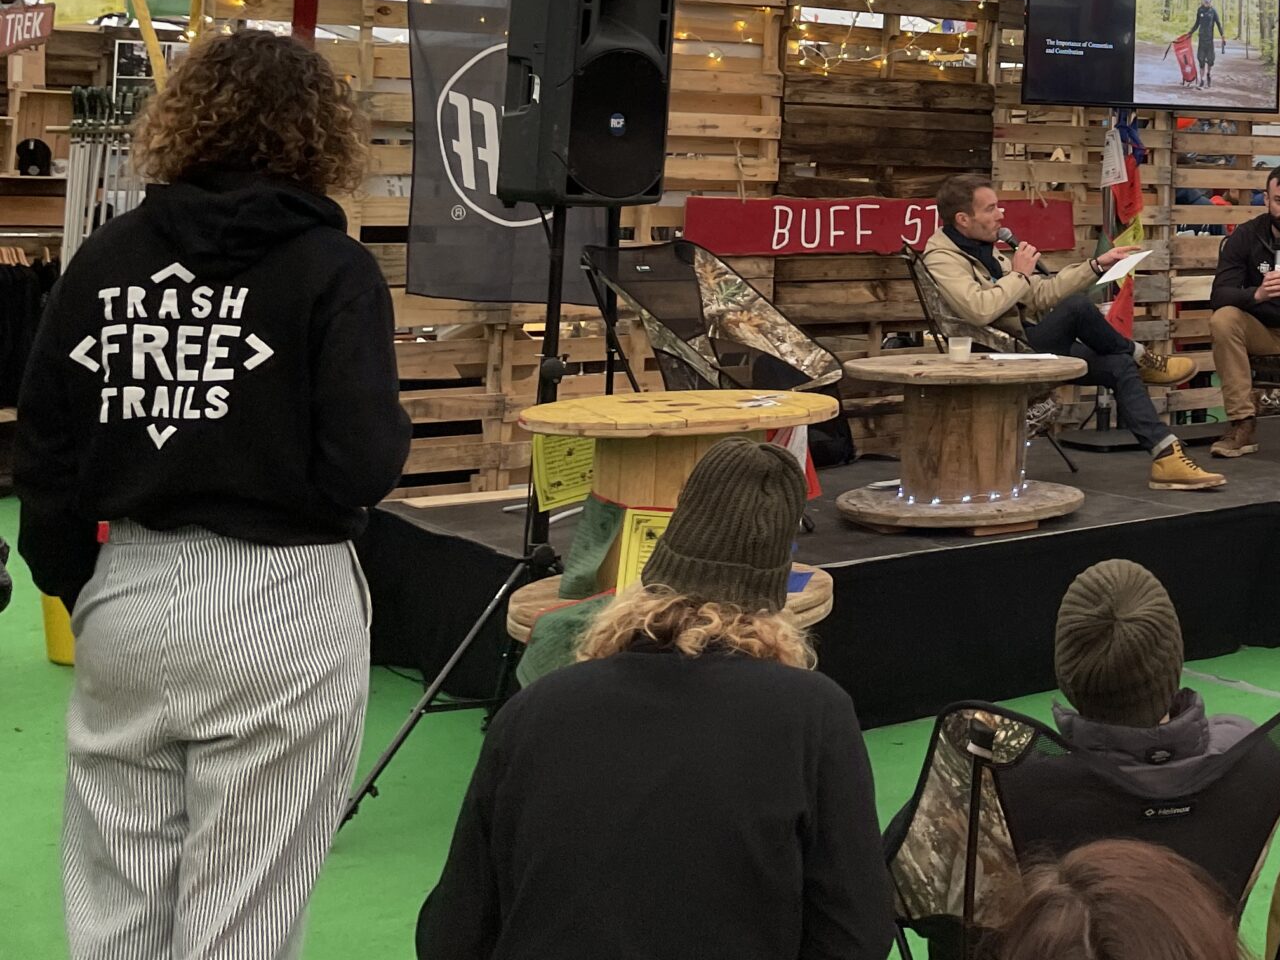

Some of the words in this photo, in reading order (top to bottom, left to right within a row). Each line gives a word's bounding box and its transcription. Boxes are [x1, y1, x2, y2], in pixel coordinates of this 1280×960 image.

[6, 12, 44, 46] TREK
[771, 203, 880, 250] BUFF
[98, 286, 249, 320] TRASH
[101, 324, 242, 383] FREE
[100, 386, 230, 423] TRAILS
